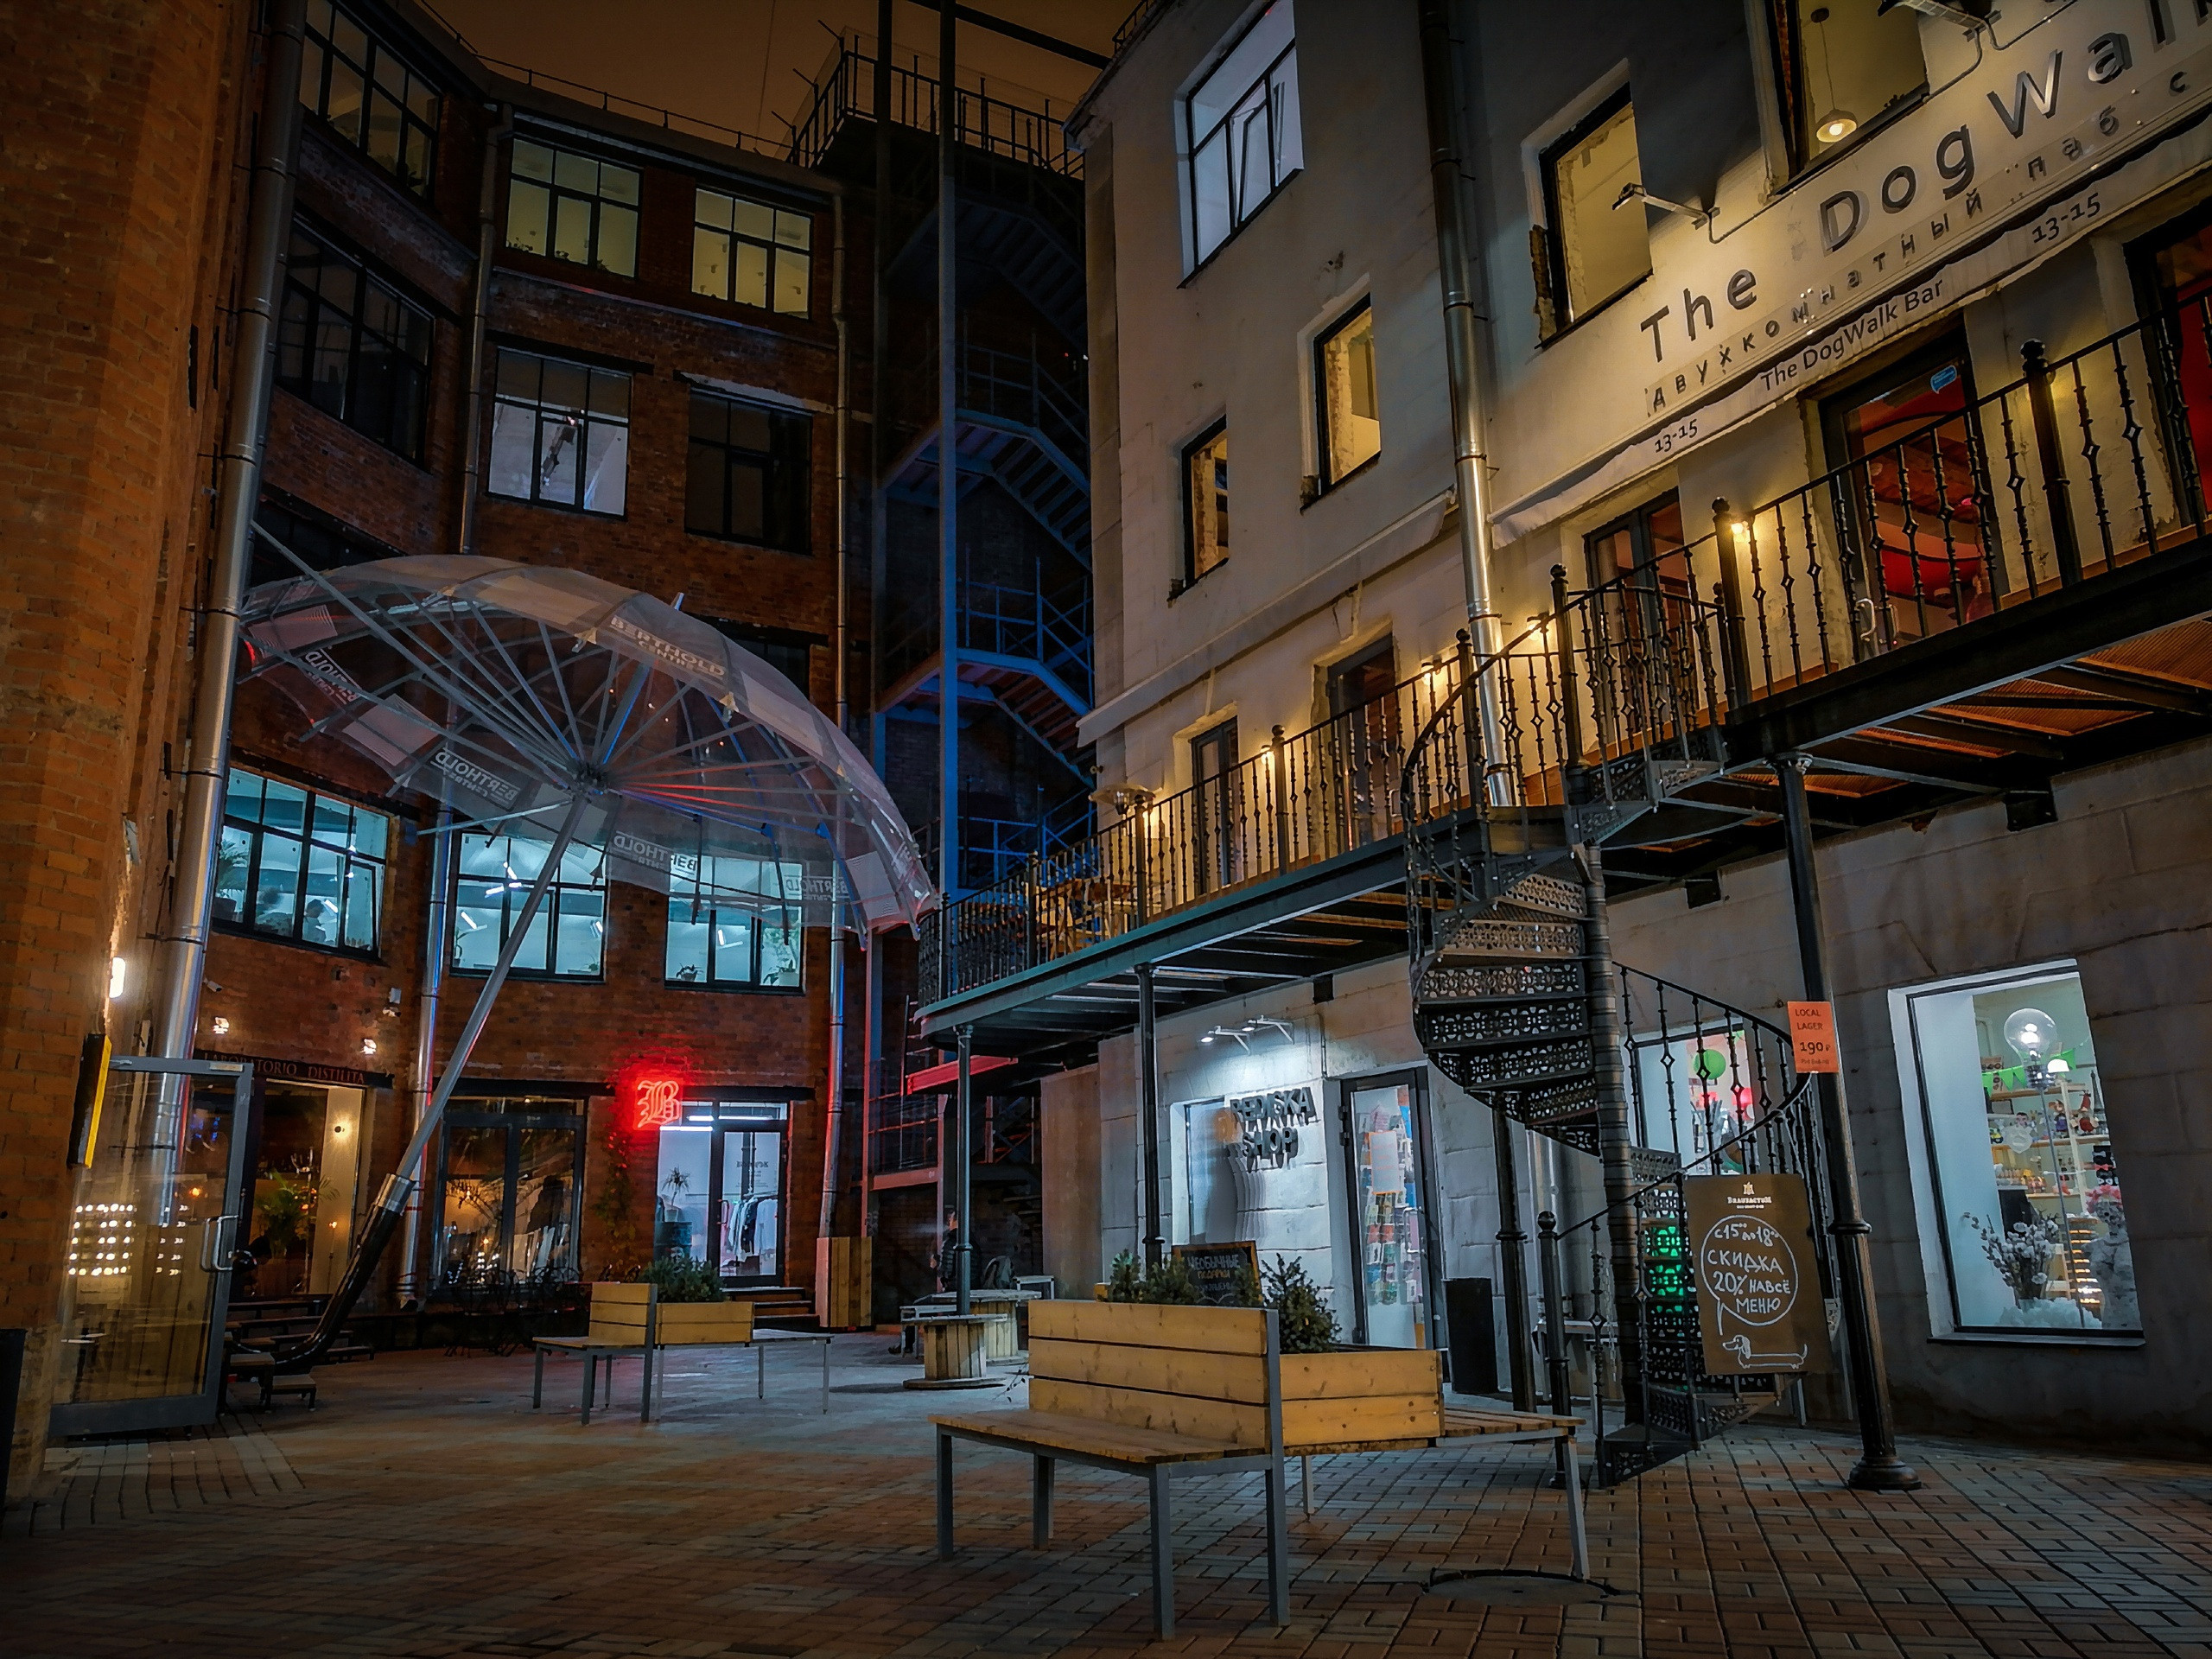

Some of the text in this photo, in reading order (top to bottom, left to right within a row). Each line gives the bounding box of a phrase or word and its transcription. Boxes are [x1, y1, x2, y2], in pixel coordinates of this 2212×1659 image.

[2027, 105, 2120, 181] паб
[1641, 0, 2212, 363] The DogWal
[2032, 193, 2101, 243] 13-15
[1760, 277, 1944, 391] The DogWalk Bar
[1654, 419, 1698, 453] 13-15
[610, 617, 724, 676] BERTHOLD
[1795, 1008, 1821, 1017] LOCAL
[1797, 1022, 1823, 1031] LAGER
[637, 1080, 679, 1128] B
[1230, 1087, 1313, 1122] REDISKA
[1243, 1128, 1296, 1159] SHOP
[1707, 1249, 1784, 1275] СКИДКА
[1713, 1271, 1748, 1296] 20%
[1735, 1297, 1781, 1313] МЕНЮ
